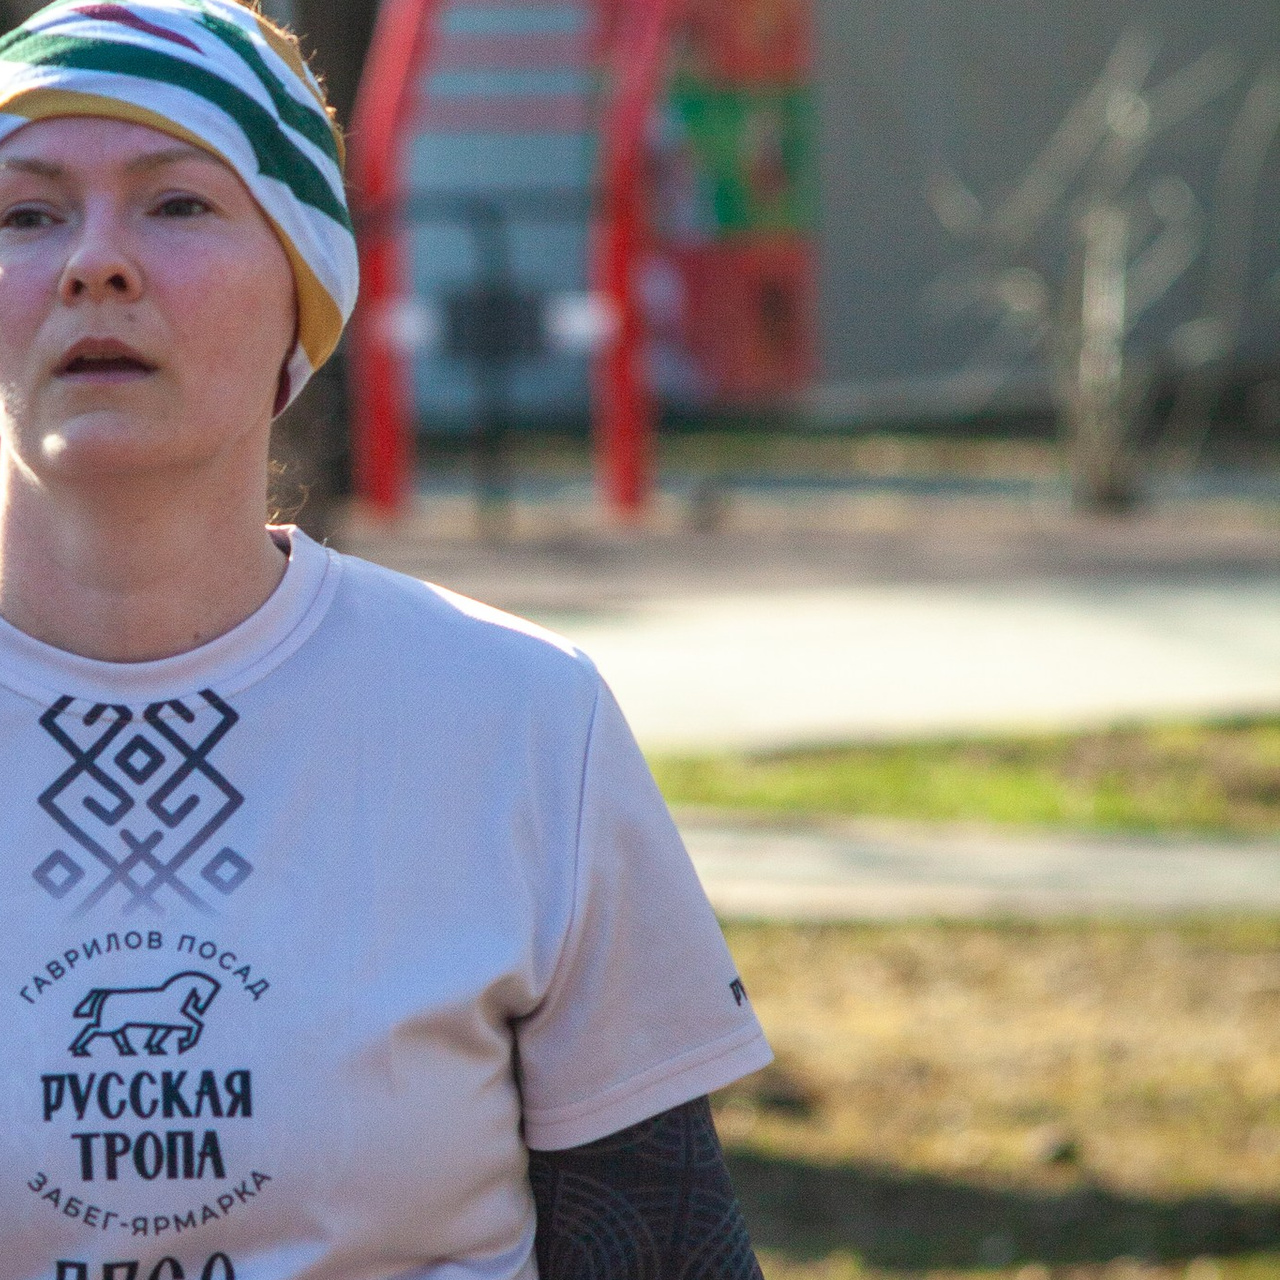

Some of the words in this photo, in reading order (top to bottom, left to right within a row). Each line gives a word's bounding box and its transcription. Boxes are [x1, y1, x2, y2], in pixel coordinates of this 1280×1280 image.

[20, 930, 163, 1004] ГАВРИЛОВ
[177, 934, 272, 1001] ПОСАД
[40, 1069, 253, 1121] РУССКАЯ
[70, 1129, 227, 1182] ТРОПА
[27, 1170, 273, 1237] ЗАБЕГ-ЯРМАРКА
